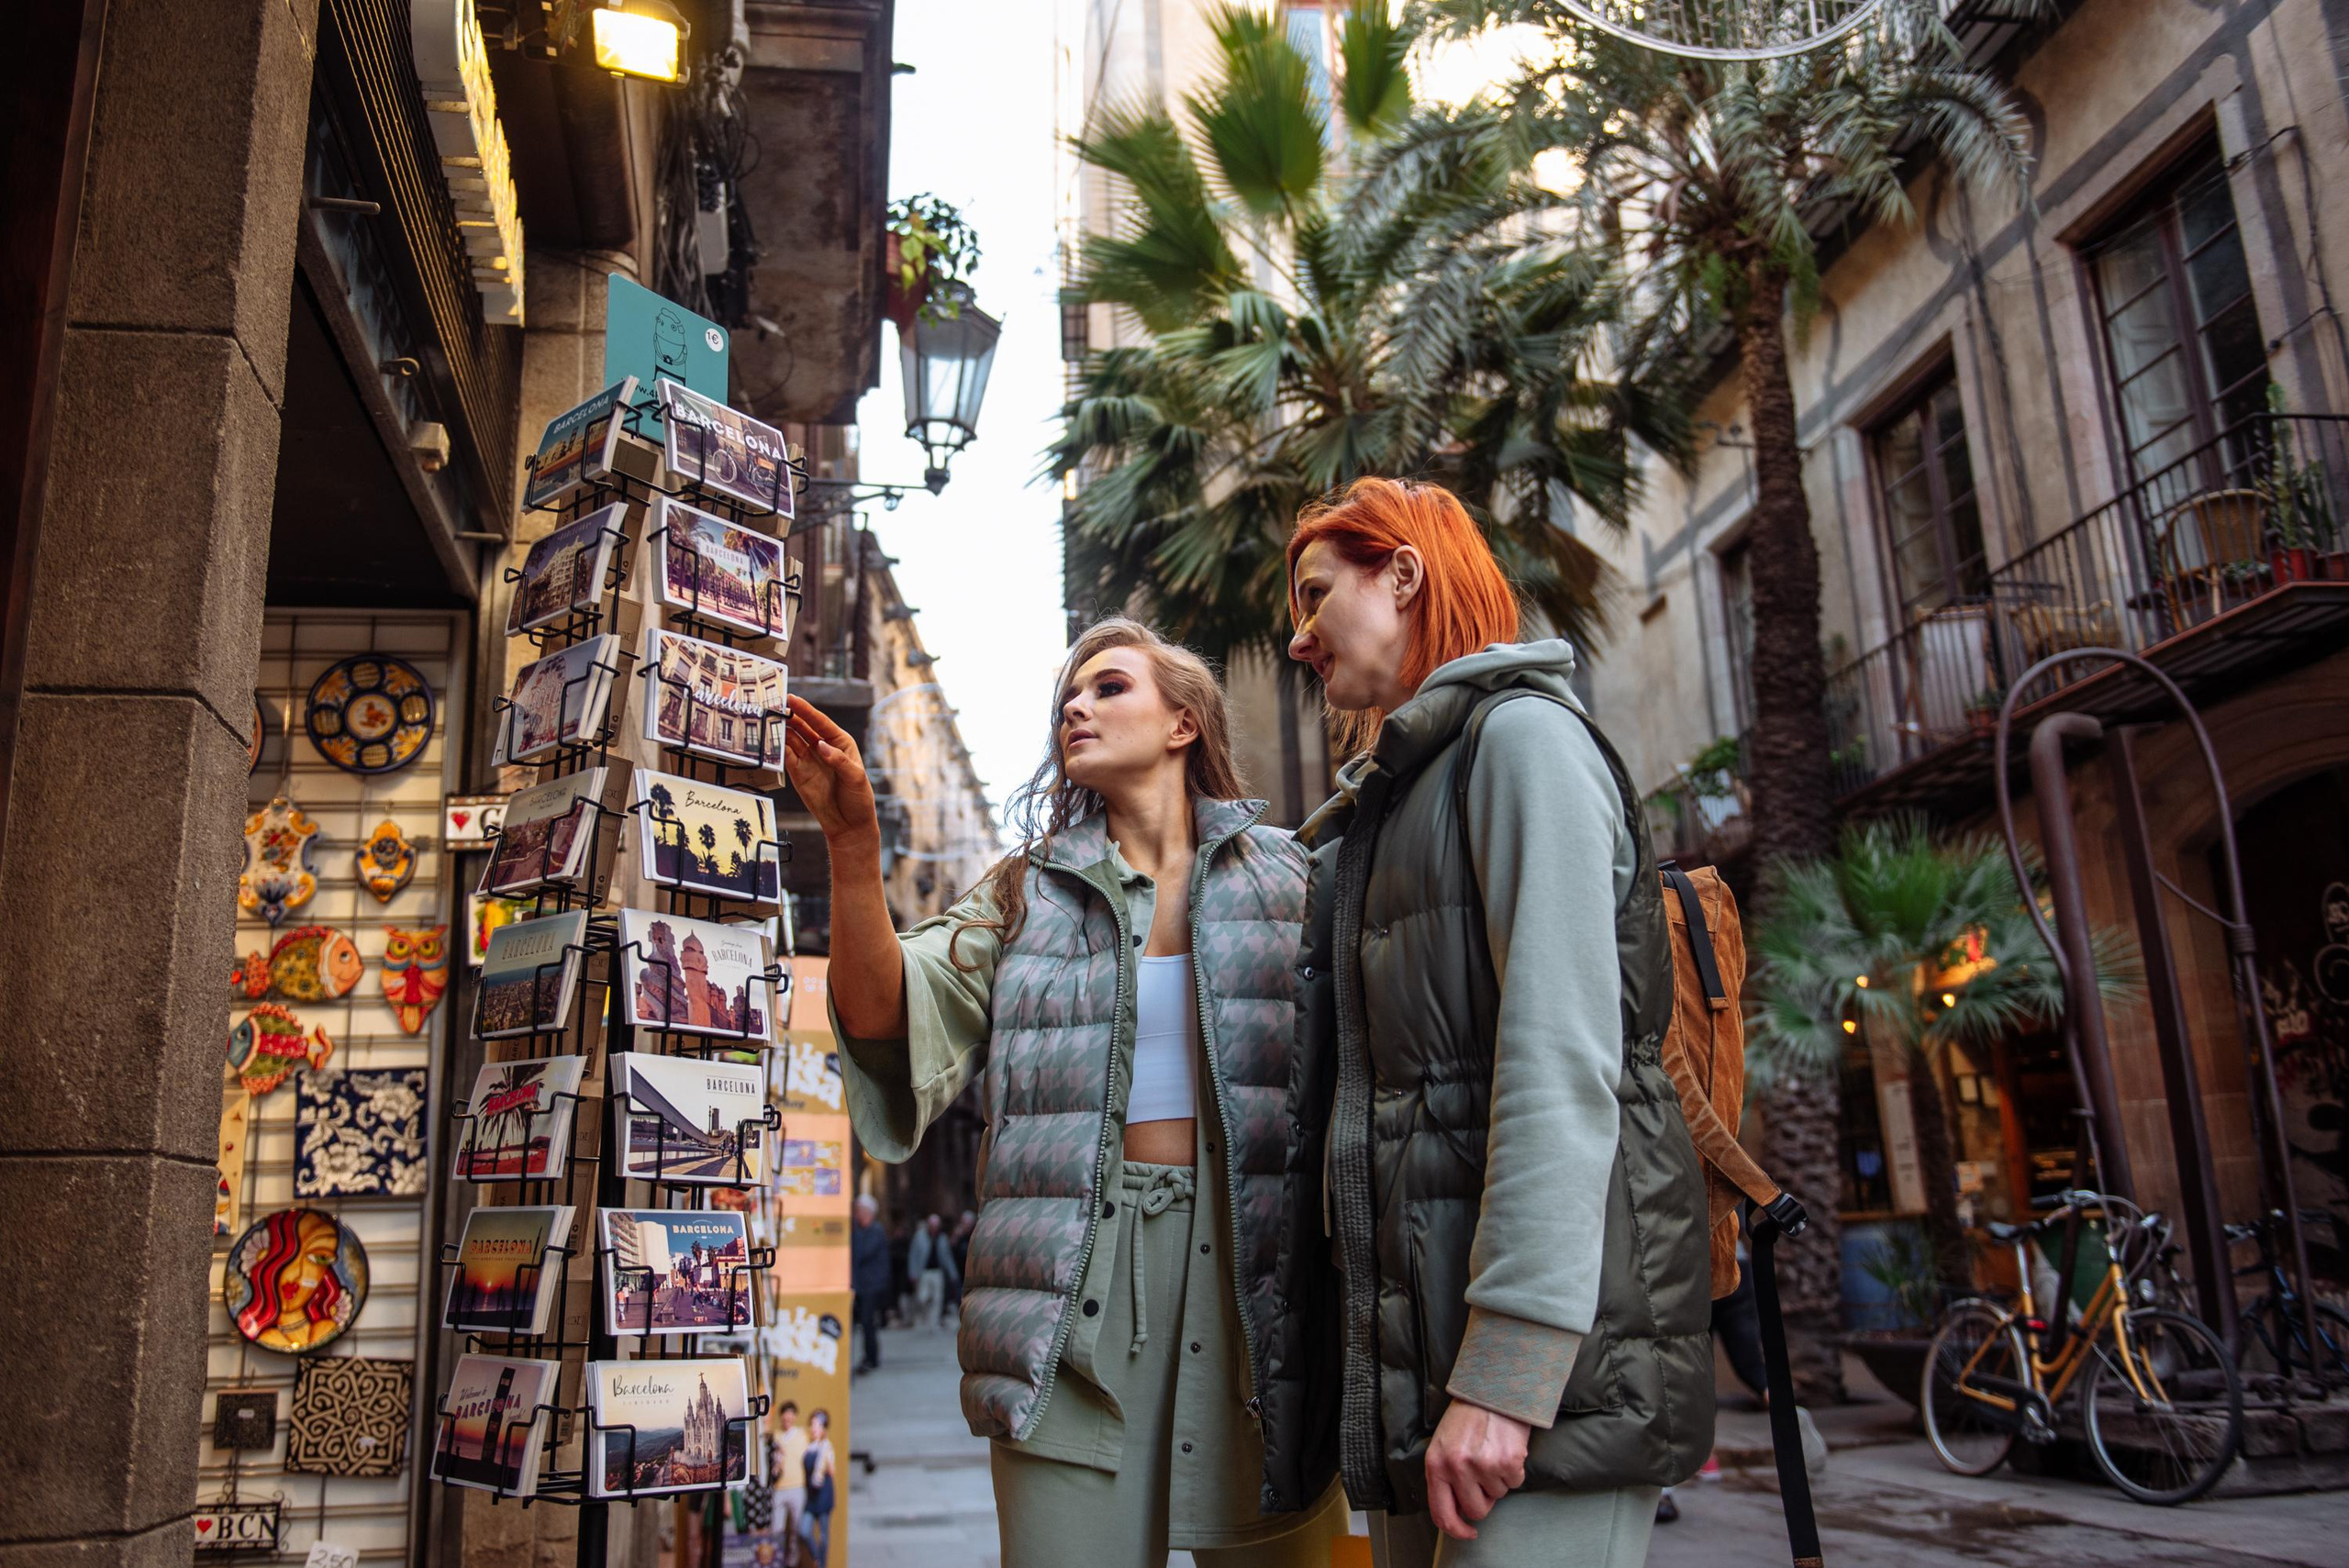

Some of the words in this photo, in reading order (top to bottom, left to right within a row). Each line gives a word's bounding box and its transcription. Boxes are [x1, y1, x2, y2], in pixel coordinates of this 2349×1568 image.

[707, 331, 719, 345] 1€
[553, 395, 609, 435] BARCELONA
[674, 402, 783, 461] BARCELONA
[706, 544, 744, 565] BARCELONA
[685, 789, 742, 815] Barcelona
[711, 949, 752, 969] BARCELONA
[707, 1078, 756, 1095] BARCELONA
[673, 1224, 735, 1235] BARCELONA
[470, 1239, 532, 1255] BARCELONA
[613, 1373, 674, 1397] Barcelona
[455, 1393, 521, 1420] BARCELONA
[216, 1514, 278, 1540] BCN
